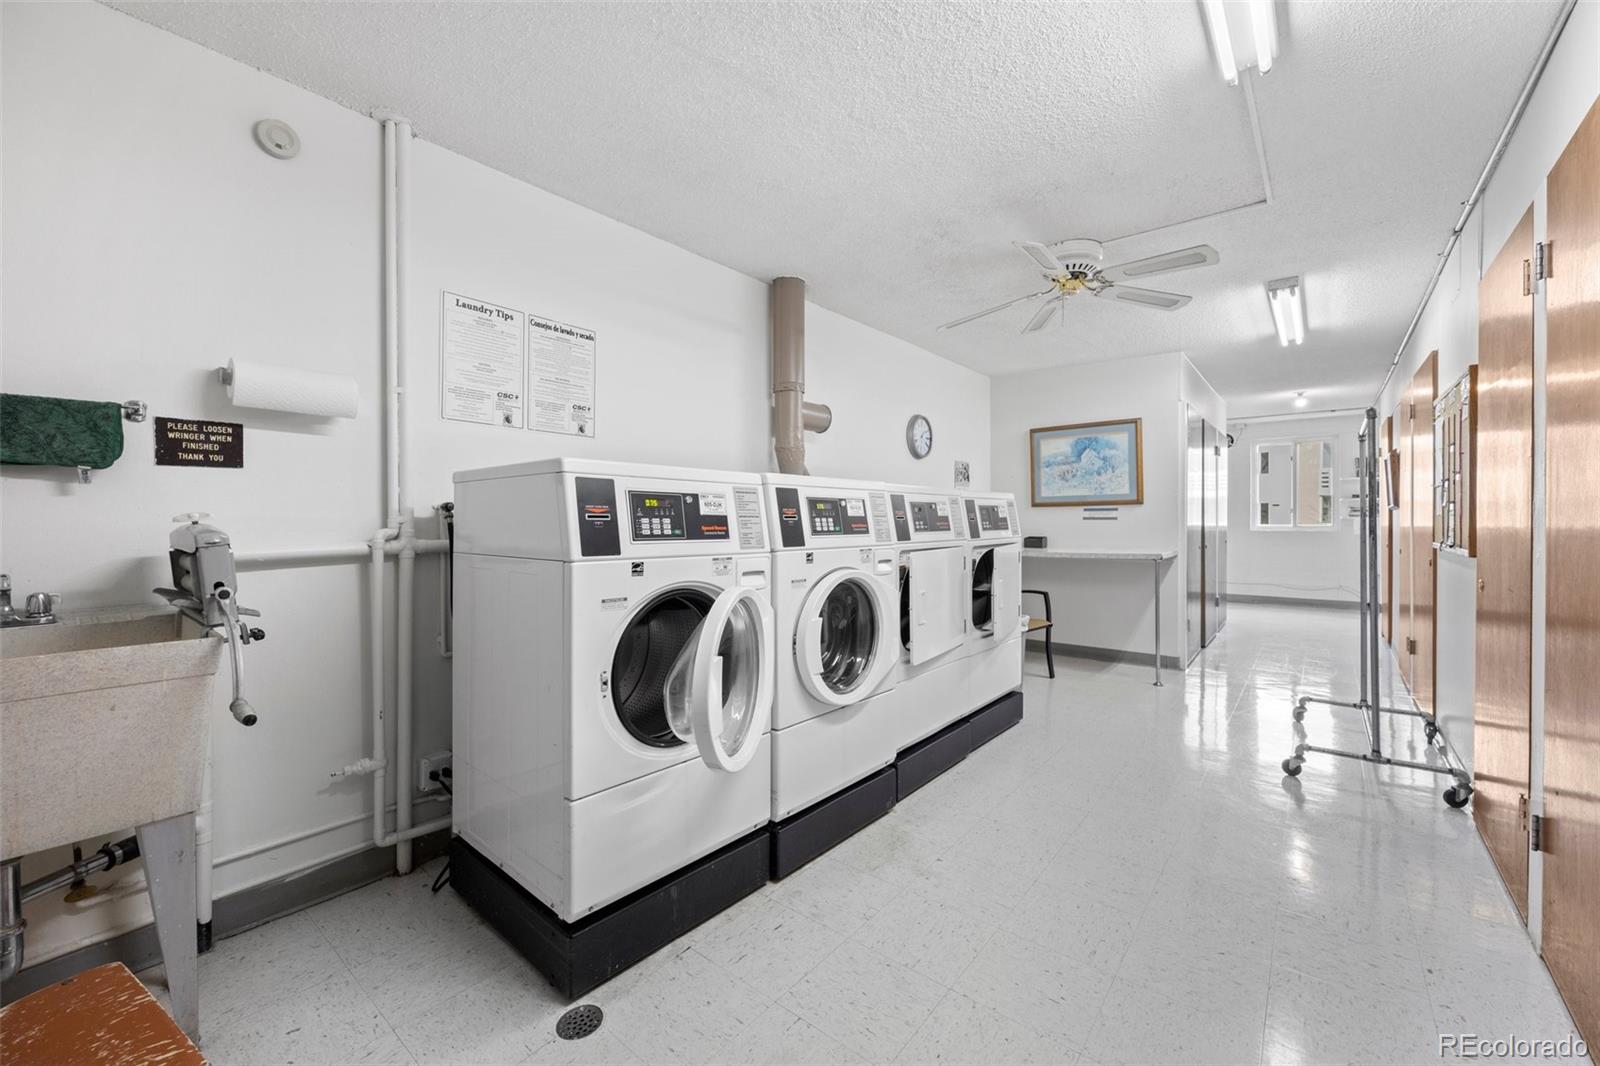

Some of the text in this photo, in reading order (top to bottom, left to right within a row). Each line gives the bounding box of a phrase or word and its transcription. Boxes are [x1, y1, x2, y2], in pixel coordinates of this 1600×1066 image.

[456, 298, 514, 321] Laundry Tips
[530, 318, 553, 331] Consejos
[553, 324, 560, 332] de
[497, 391, 514, 400] CSC
[572, 404, 587, 412] CSC
[167, 422, 233, 434] PLEASE LOOSEN
[167, 431, 232, 442] WRINGER WHEN
[182, 442, 220, 451] FINISHED
[177, 452, 224, 462] THANK YOU
